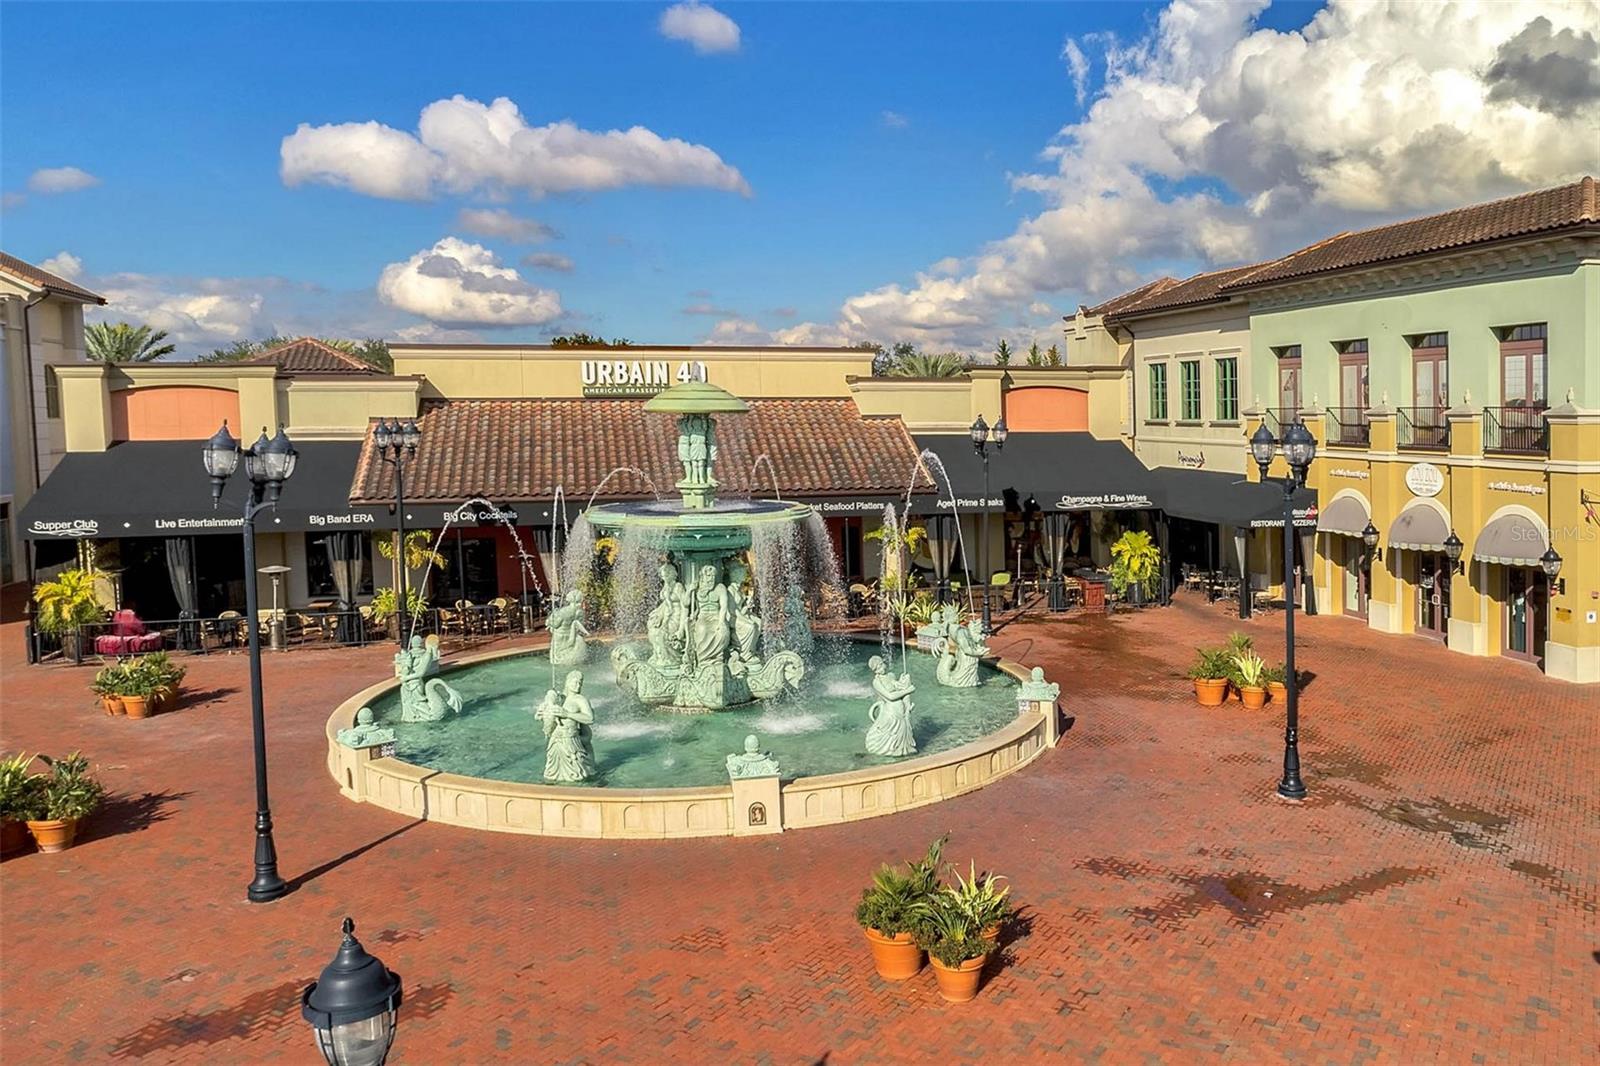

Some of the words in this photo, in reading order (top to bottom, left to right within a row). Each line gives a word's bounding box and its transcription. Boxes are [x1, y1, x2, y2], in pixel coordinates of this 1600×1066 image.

[581, 361, 669, 385] URBAIN
[936, 499, 956, 509] Aged
[957, 499, 978, 507] Prime
[979, 498, 1004, 507] Seaks
[1062, 495, 1103, 504] Champagne
[1103, 494, 1109, 502] &
[1110, 494, 1126, 502] Fine
[1126, 494, 1148, 502] Wines
[823, 502, 855, 511] Seafood
[856, 502, 885, 510] Platters
[309, 515, 326, 526] Big
[326, 514, 352, 524] Band
[352, 513, 375, 523] ERA
[443, 512, 459, 522] Big
[460, 512, 477, 521] City
[34, 521, 73, 531] Supper
[73, 519, 99, 530] Club
[155, 519, 177, 529] Live
[178, 517, 244, 528] Entertainment
[1250, 520, 1286, 528] RISTORANT
